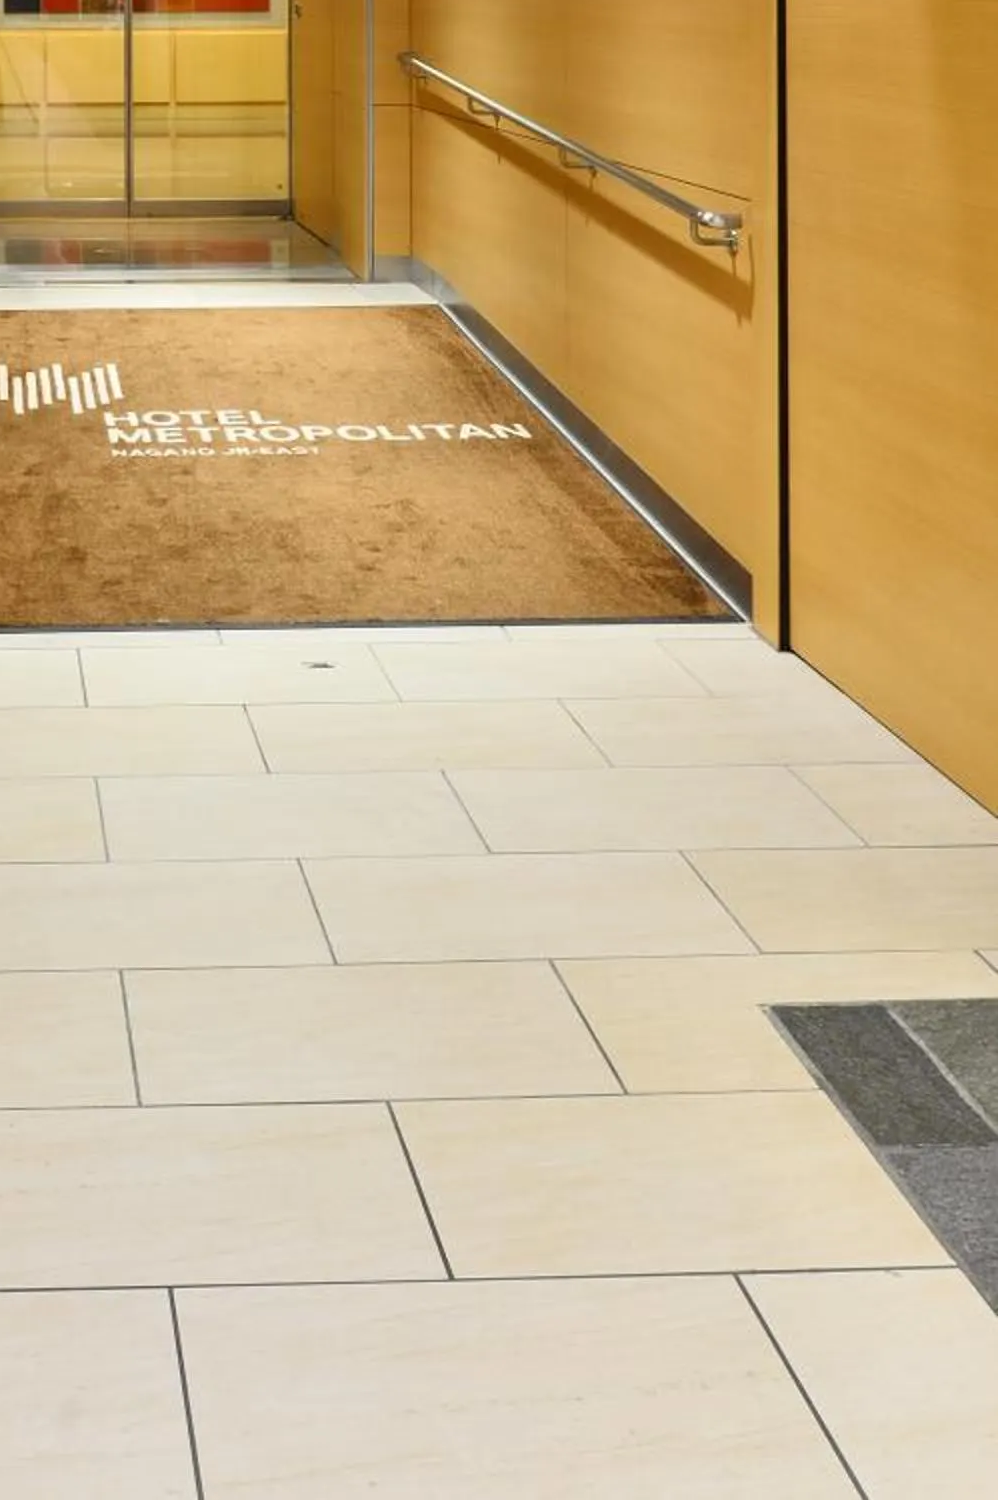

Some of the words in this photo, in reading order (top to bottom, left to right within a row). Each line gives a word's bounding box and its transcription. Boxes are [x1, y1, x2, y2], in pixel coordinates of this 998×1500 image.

[103, 409, 281, 427] HOTEL
[106, 423, 532, 444] METROPOLITAN
[111, 447, 216, 458] NAGANO
